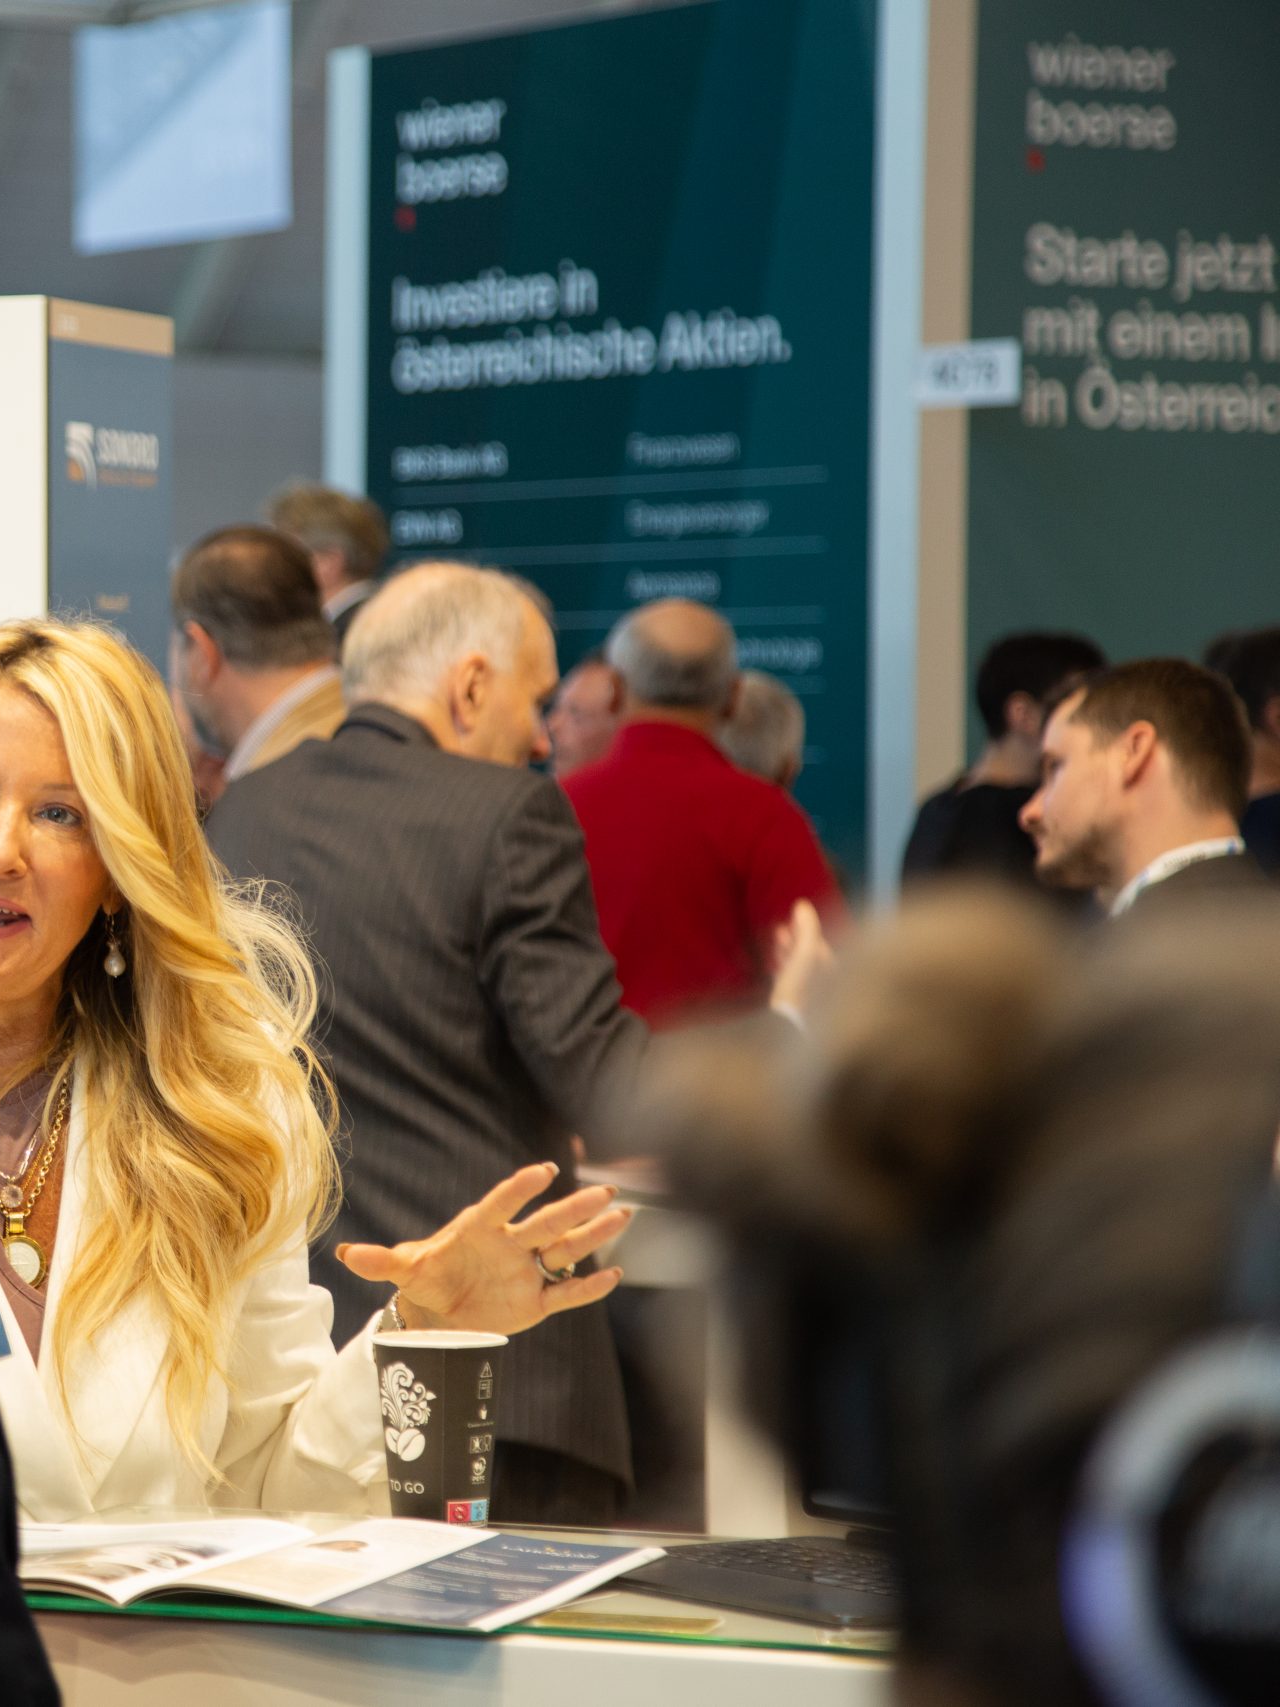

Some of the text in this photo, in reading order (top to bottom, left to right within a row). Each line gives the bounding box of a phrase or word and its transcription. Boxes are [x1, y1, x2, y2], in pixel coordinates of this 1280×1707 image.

[1028, 34, 1174, 91] wiener
[397, 98, 506, 151] wiener
[1026, 89, 1177, 150] boerse
[397, 153, 507, 204] boerse
[1025, 223, 1277, 302] Starte jetzt
[393, 258, 597, 331] Investiere in
[392, 319, 655, 393] österreichische
[1024, 298, 1102, 357] mit
[1108, 299, 1252, 362] einem
[1024, 366, 1068, 428] in
[404, 1482, 425, 1495] GO
